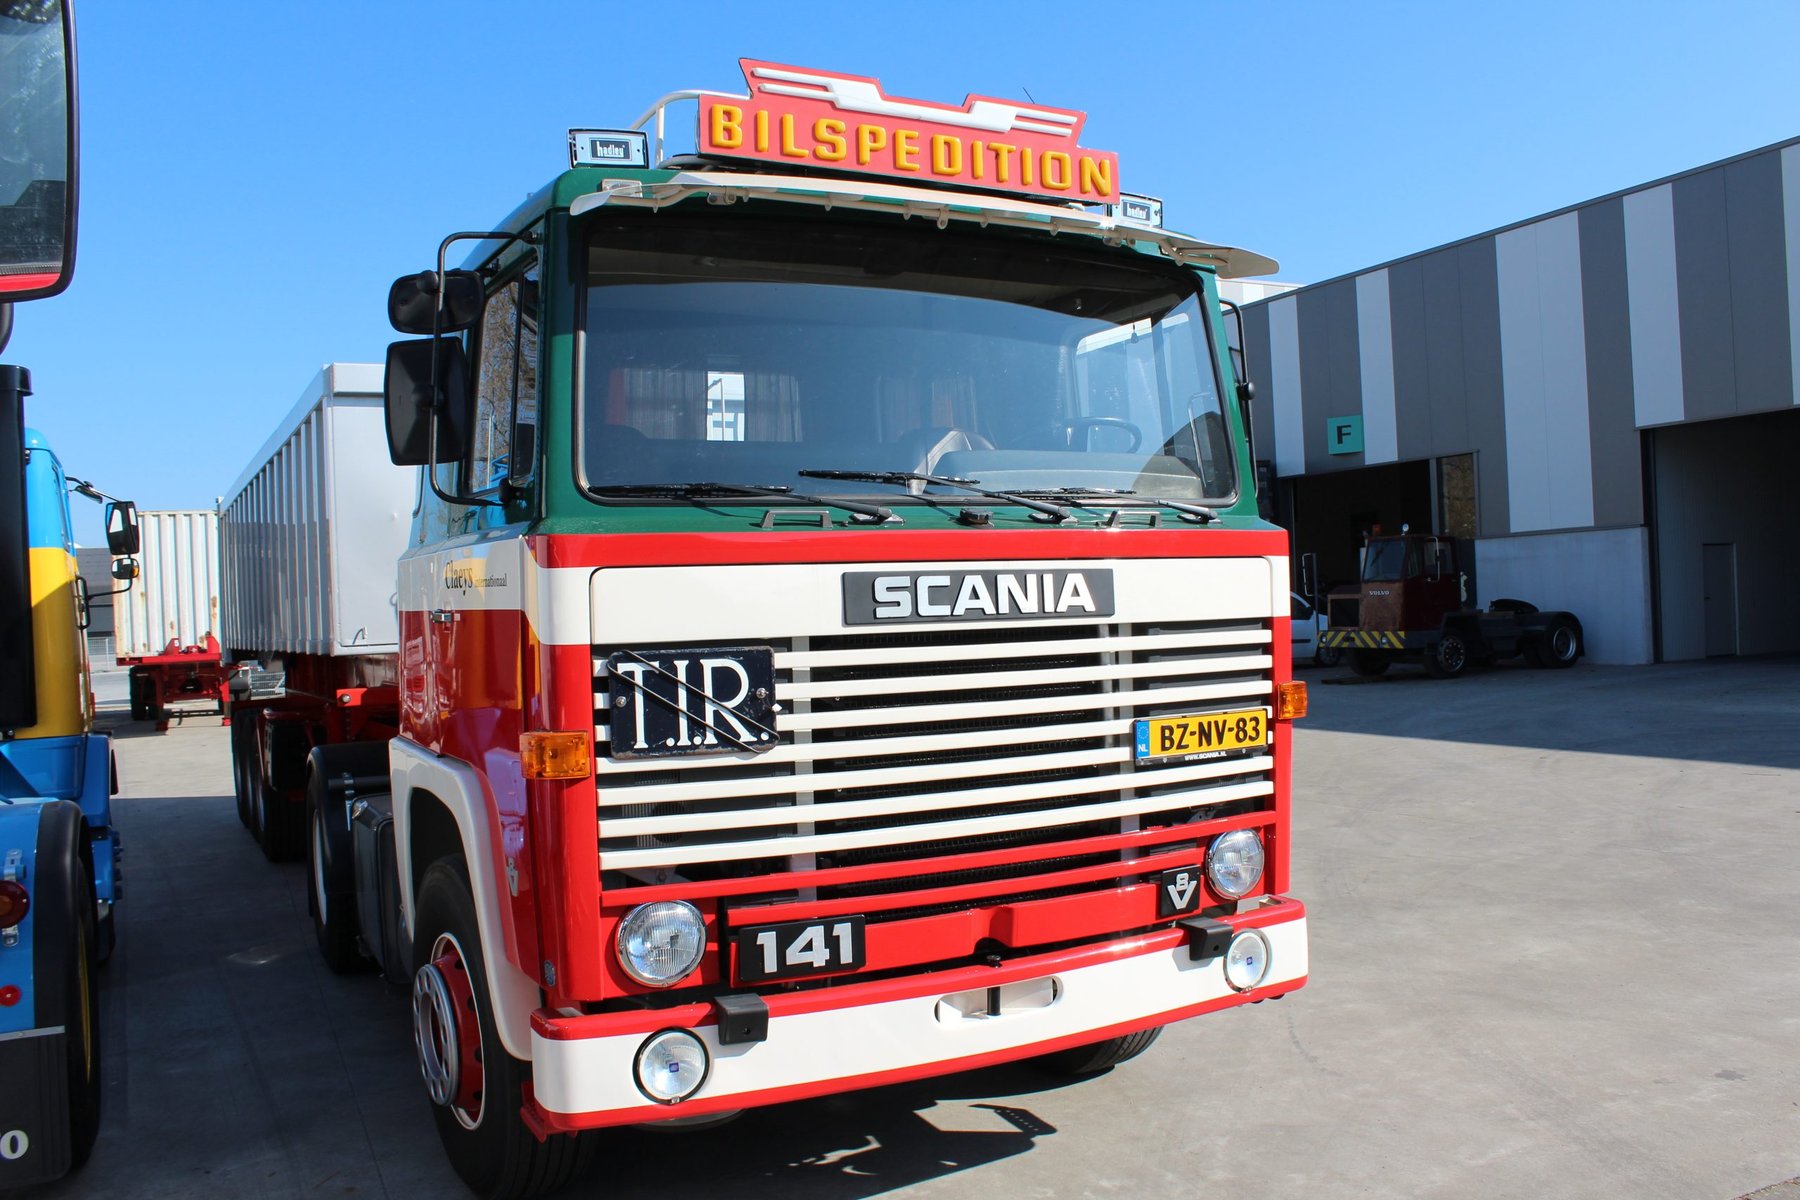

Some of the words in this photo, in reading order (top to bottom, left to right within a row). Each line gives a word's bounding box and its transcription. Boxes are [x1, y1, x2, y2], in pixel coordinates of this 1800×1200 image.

[596, 140, 625, 158] hadley
[710, 103, 1112, 197] BILSPEDITION
[1336, 424, 1352, 445] F
[445, 560, 473, 596] Claeys
[873, 573, 1097, 619] SCANIA
[1137, 743, 1149, 753] NL
[1160, 716, 1261, 752] BZ-NV-83
[756, 922, 853, 974] 141
